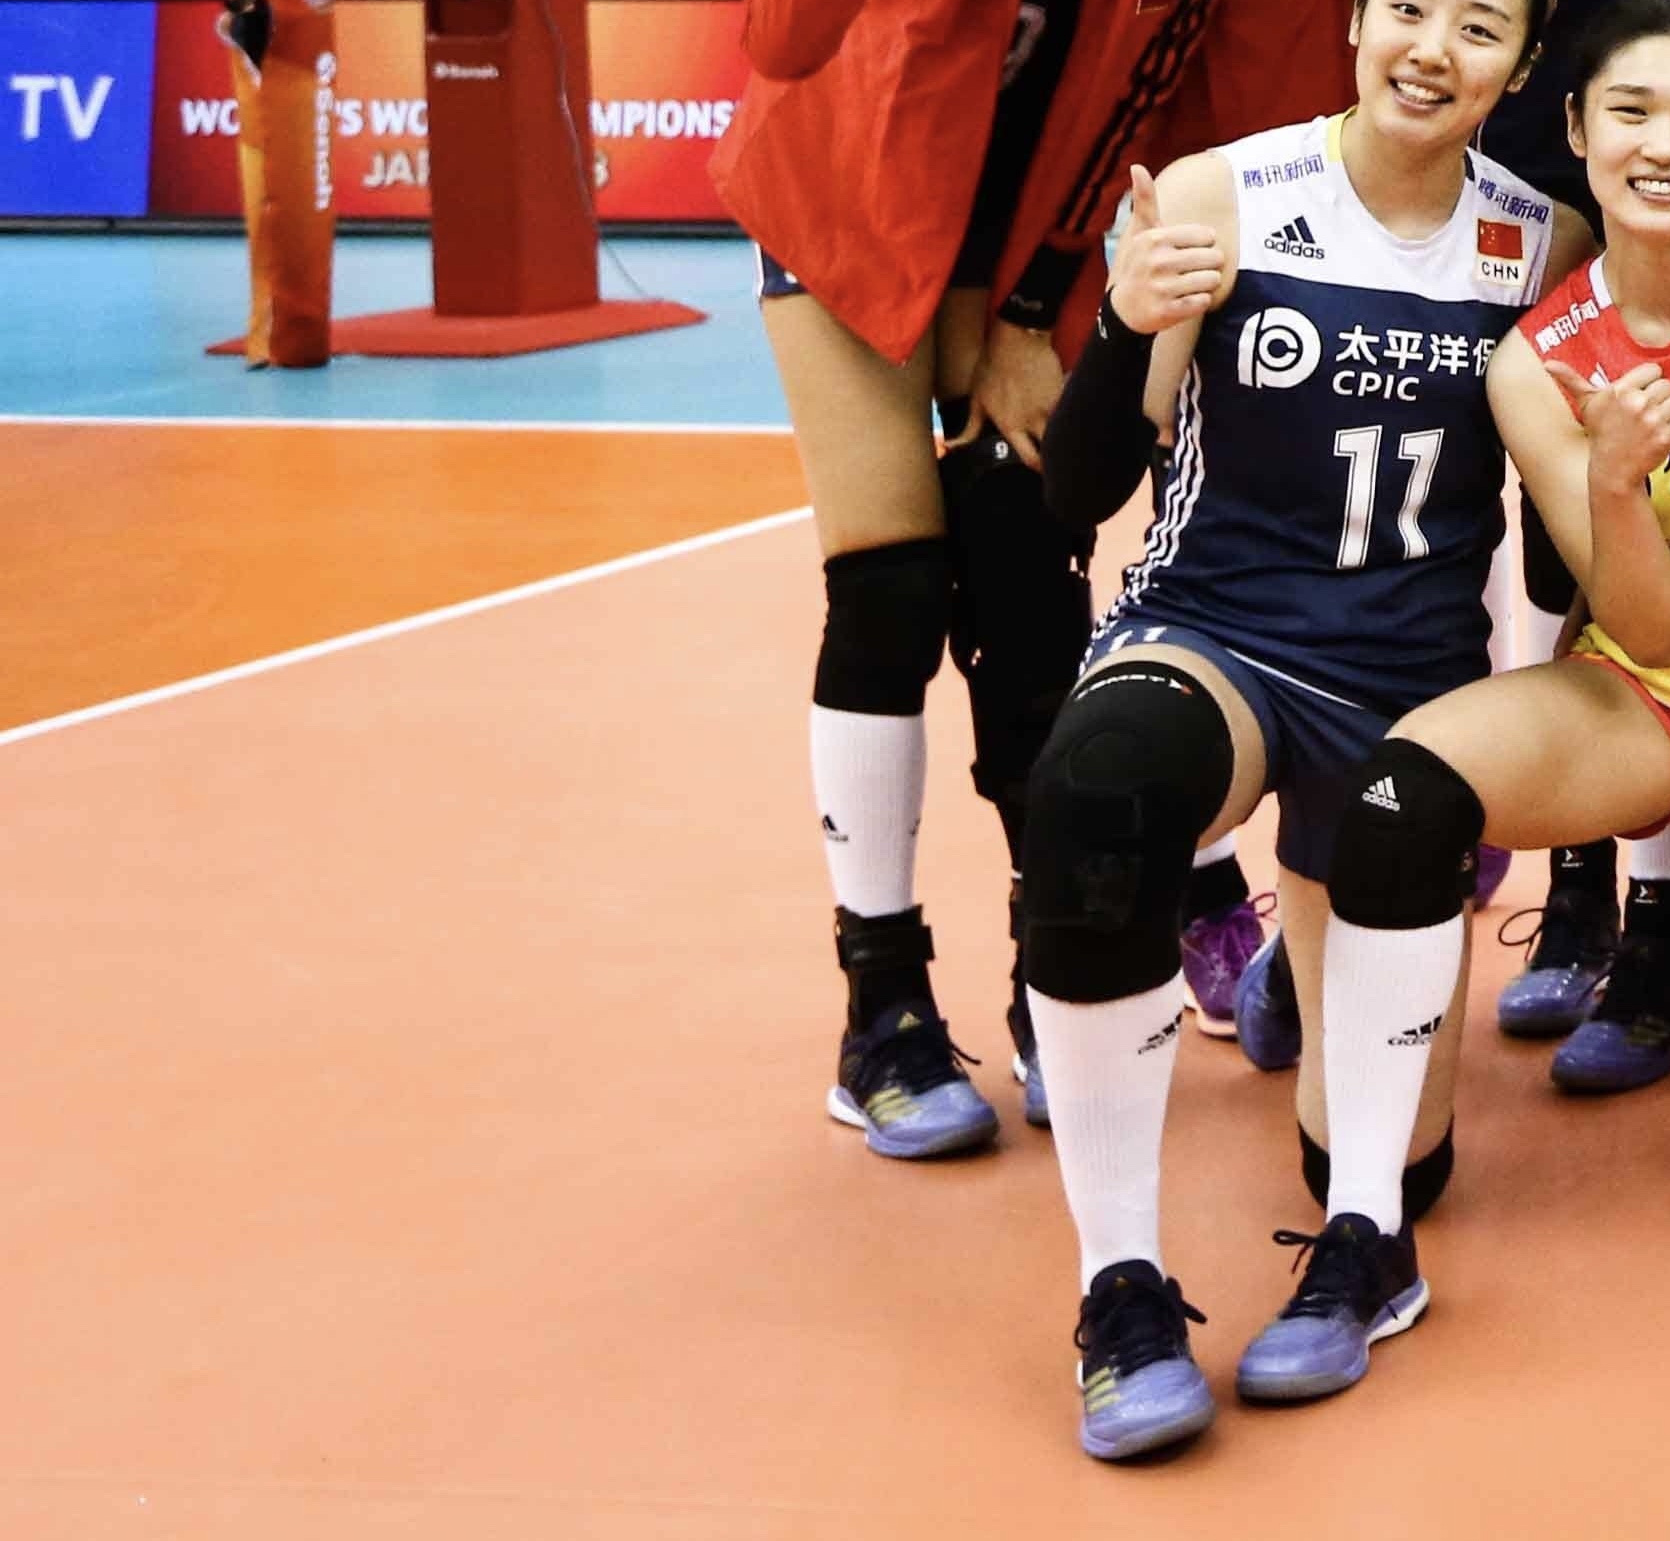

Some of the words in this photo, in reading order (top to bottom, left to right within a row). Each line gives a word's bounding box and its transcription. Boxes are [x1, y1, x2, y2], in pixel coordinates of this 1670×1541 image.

[10, 74, 115, 141] TV
[1243, 153, 1325, 190] 腾讯新闻
[1264, 236, 1326, 261] adidas
[1480, 261, 1520, 281] CHN
[1332, 370, 1420, 402] CPIC
[1334, 424, 1444, 569] 11
[1361, 791, 1401, 812] adidas
